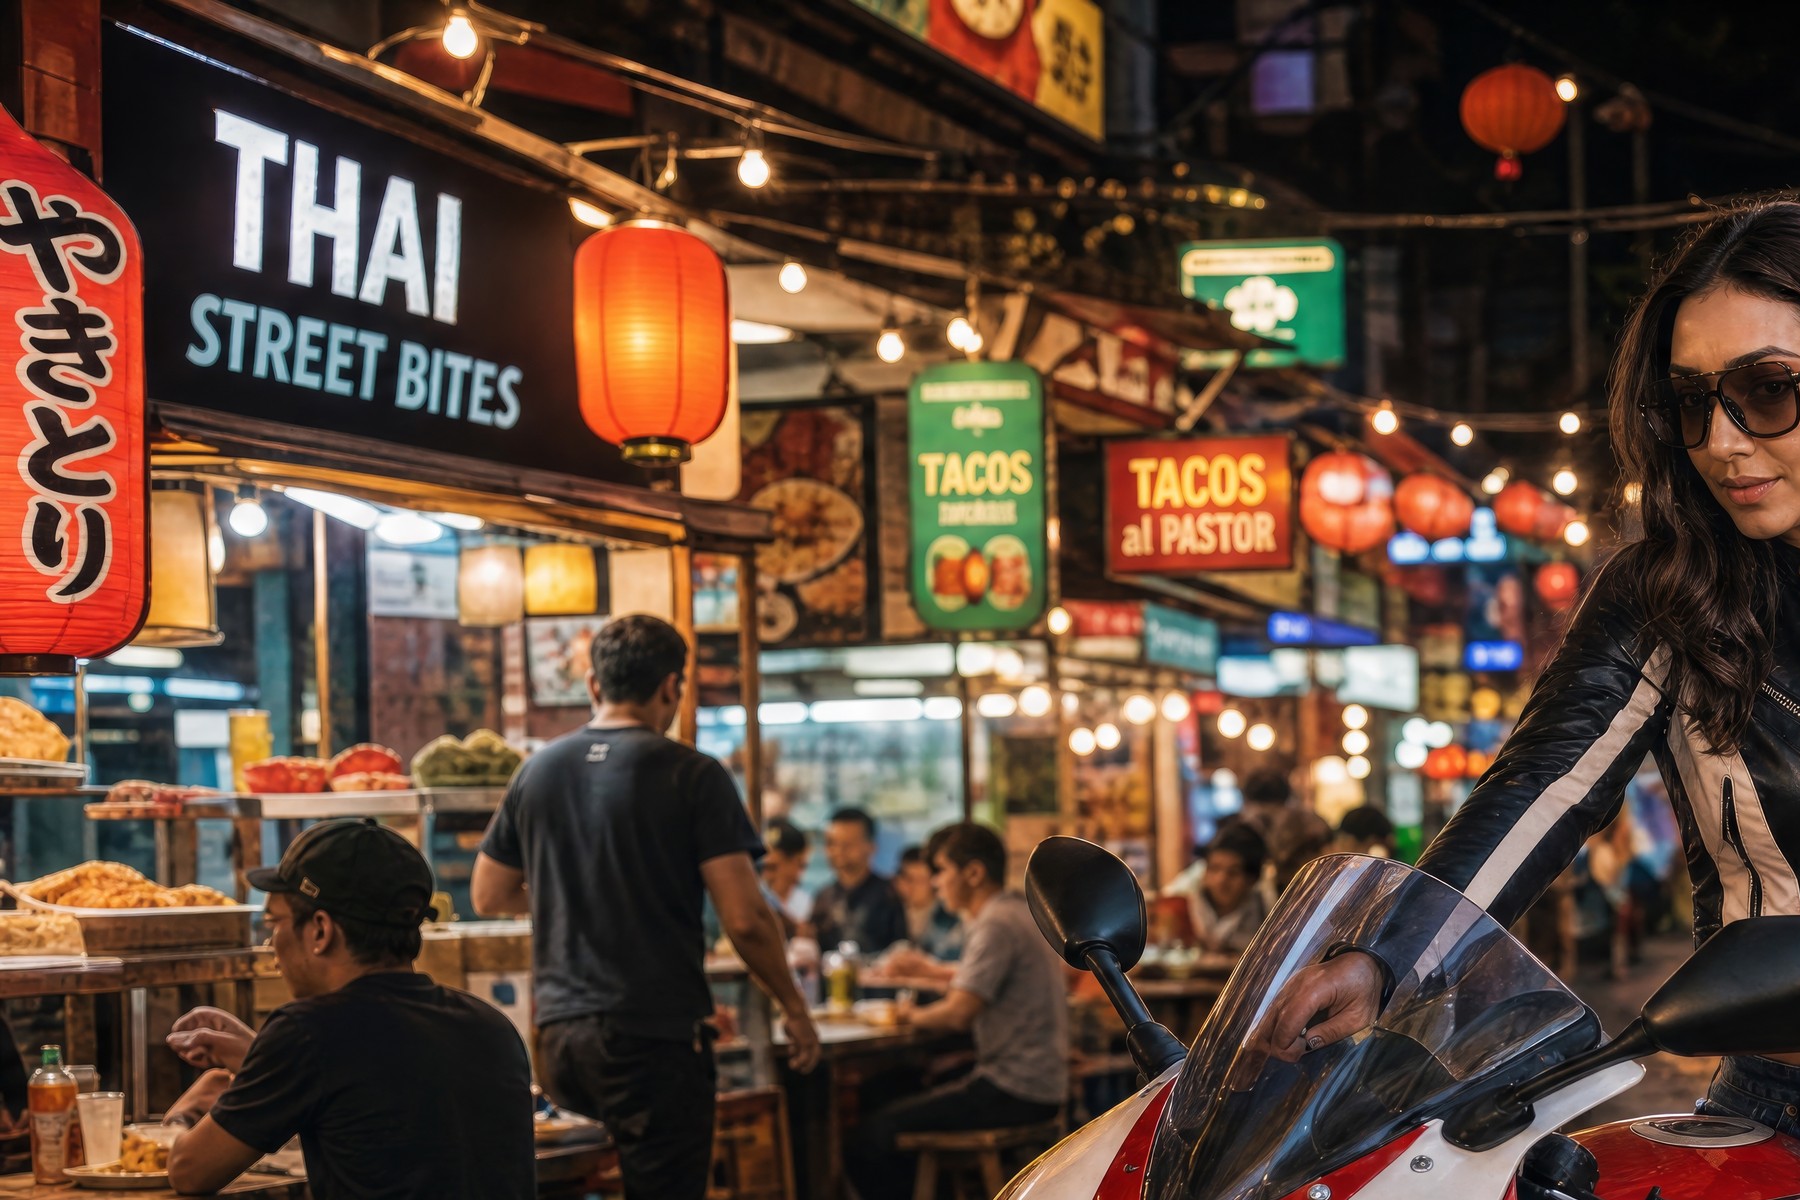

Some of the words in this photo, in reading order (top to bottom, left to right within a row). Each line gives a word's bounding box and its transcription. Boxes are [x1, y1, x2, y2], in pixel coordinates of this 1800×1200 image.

[214, 109, 462, 324] THAI
[0, 180, 126, 604] やきとり
[186, 293, 388, 401] STREET
[395, 341, 523, 430] BITES
[918, 449, 1033, 496] TACOS
[1128, 453, 1267, 509] TACOS
[1121, 513, 1154, 557] al
[1160, 511, 1277, 555] PASTOR
